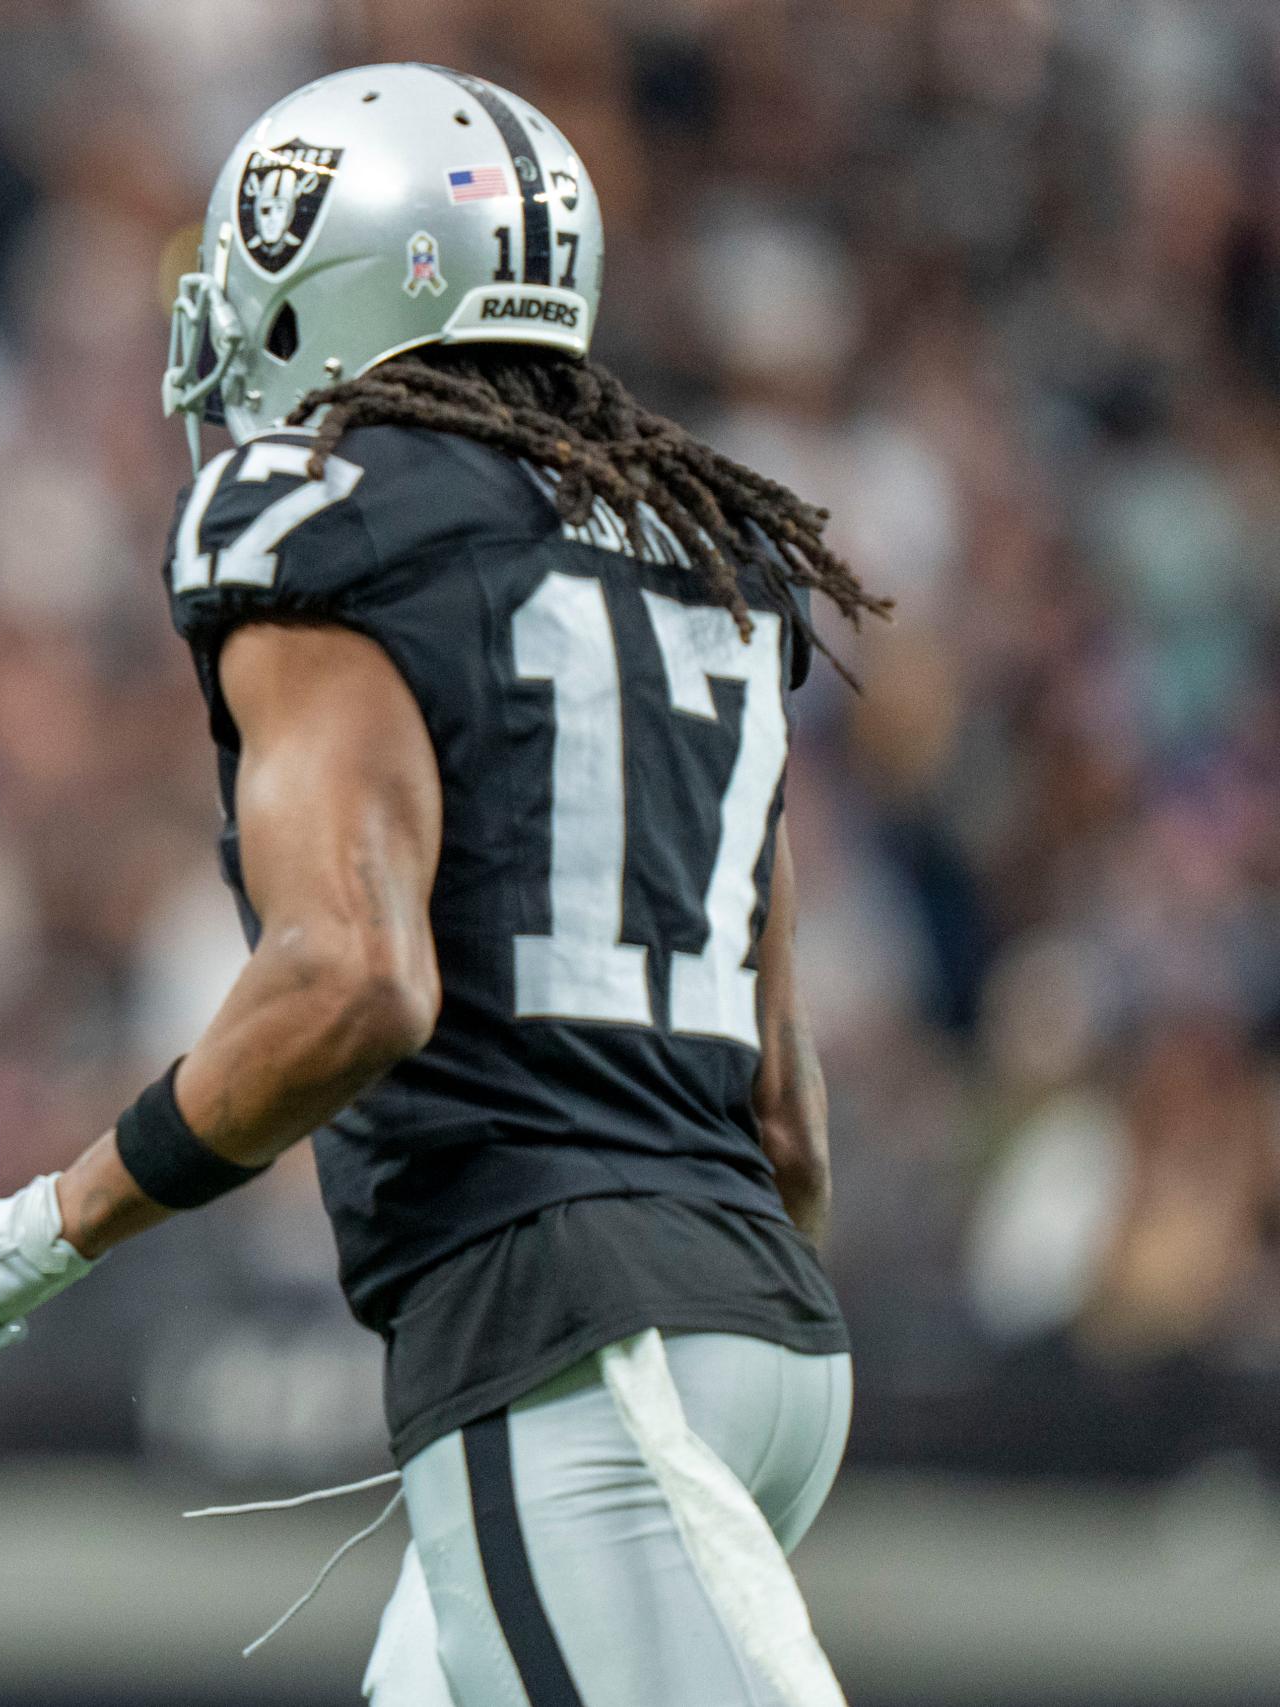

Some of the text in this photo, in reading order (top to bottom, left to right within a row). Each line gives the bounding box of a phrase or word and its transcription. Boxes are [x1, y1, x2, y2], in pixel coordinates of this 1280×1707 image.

[481, 299, 580, 328] RAIDERS
[172, 442, 365, 594] 17
[513, 571, 788, 1051] 17
